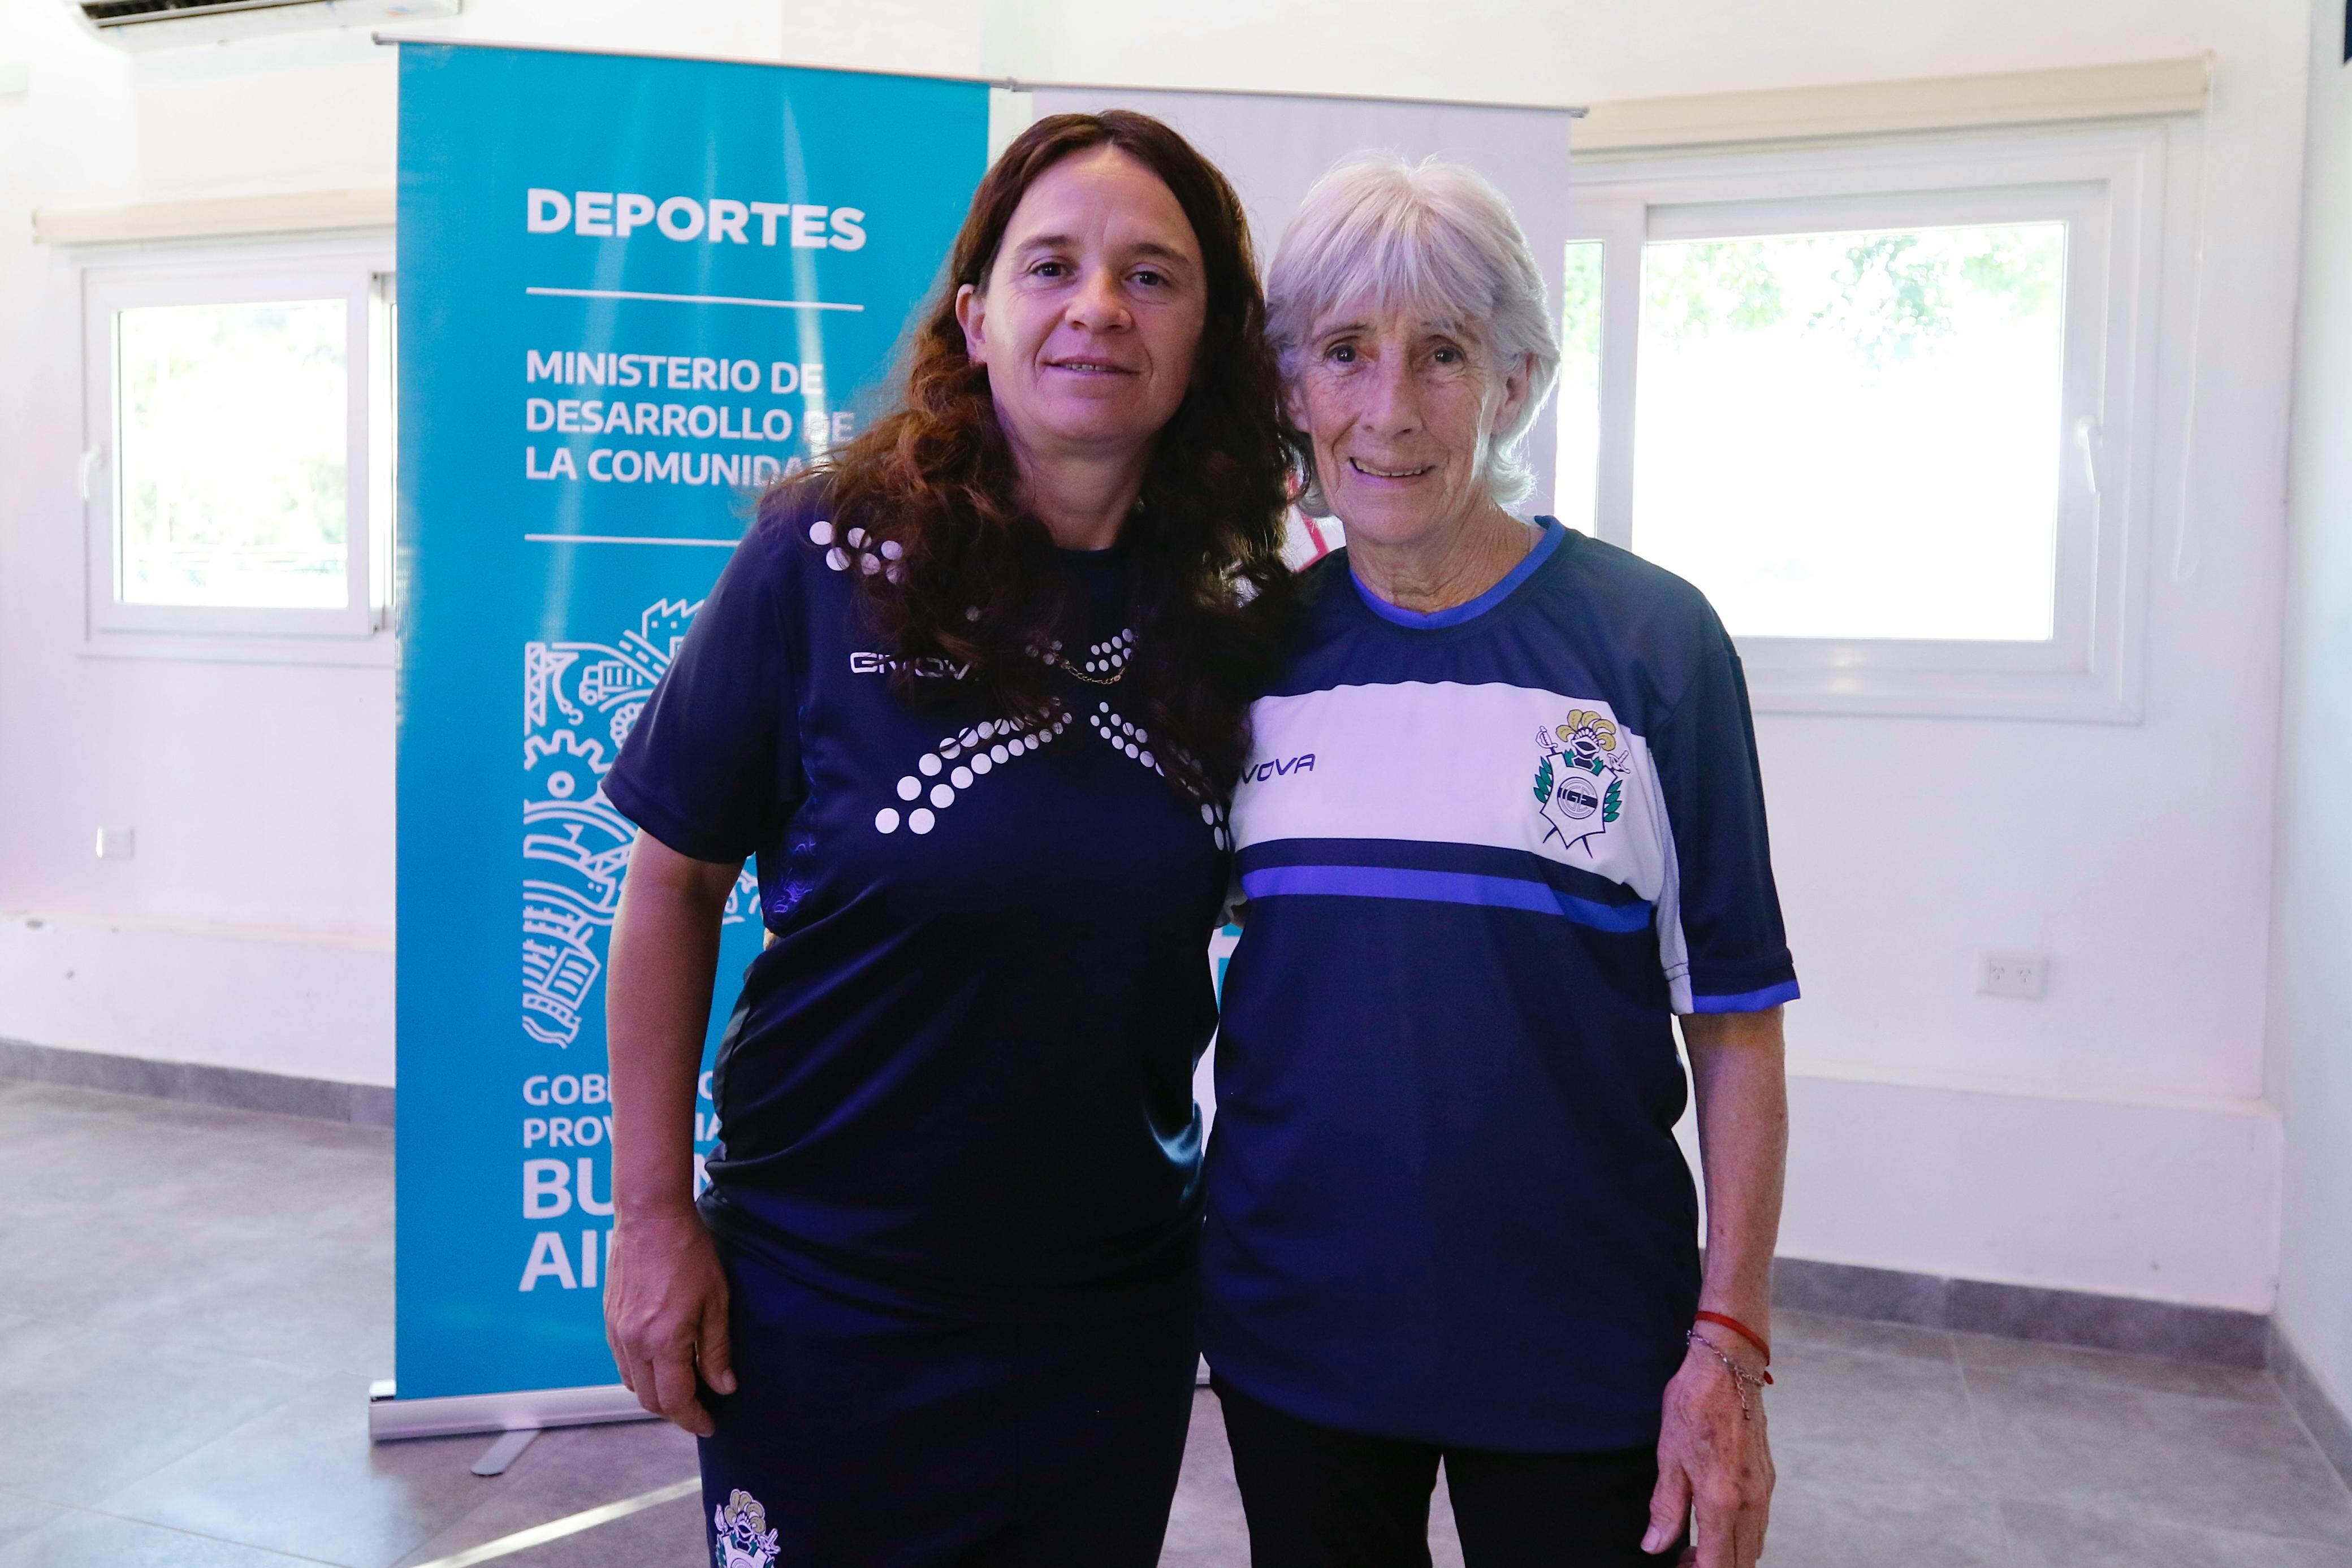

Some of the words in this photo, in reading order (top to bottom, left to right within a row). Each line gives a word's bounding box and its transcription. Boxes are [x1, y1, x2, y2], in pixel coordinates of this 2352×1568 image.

[527, 188, 867, 252] DEPORTES
[526, 349, 762, 393] MINISTERIO
[771, 362, 826, 395] DE
[525, 397, 793, 442] DESARROLLO
[803, 409, 855, 443] DE
[525, 446, 579, 482] LA
[587, 449, 806, 487] COMUNIDA
[1240, 753, 1316, 785] VOVA
